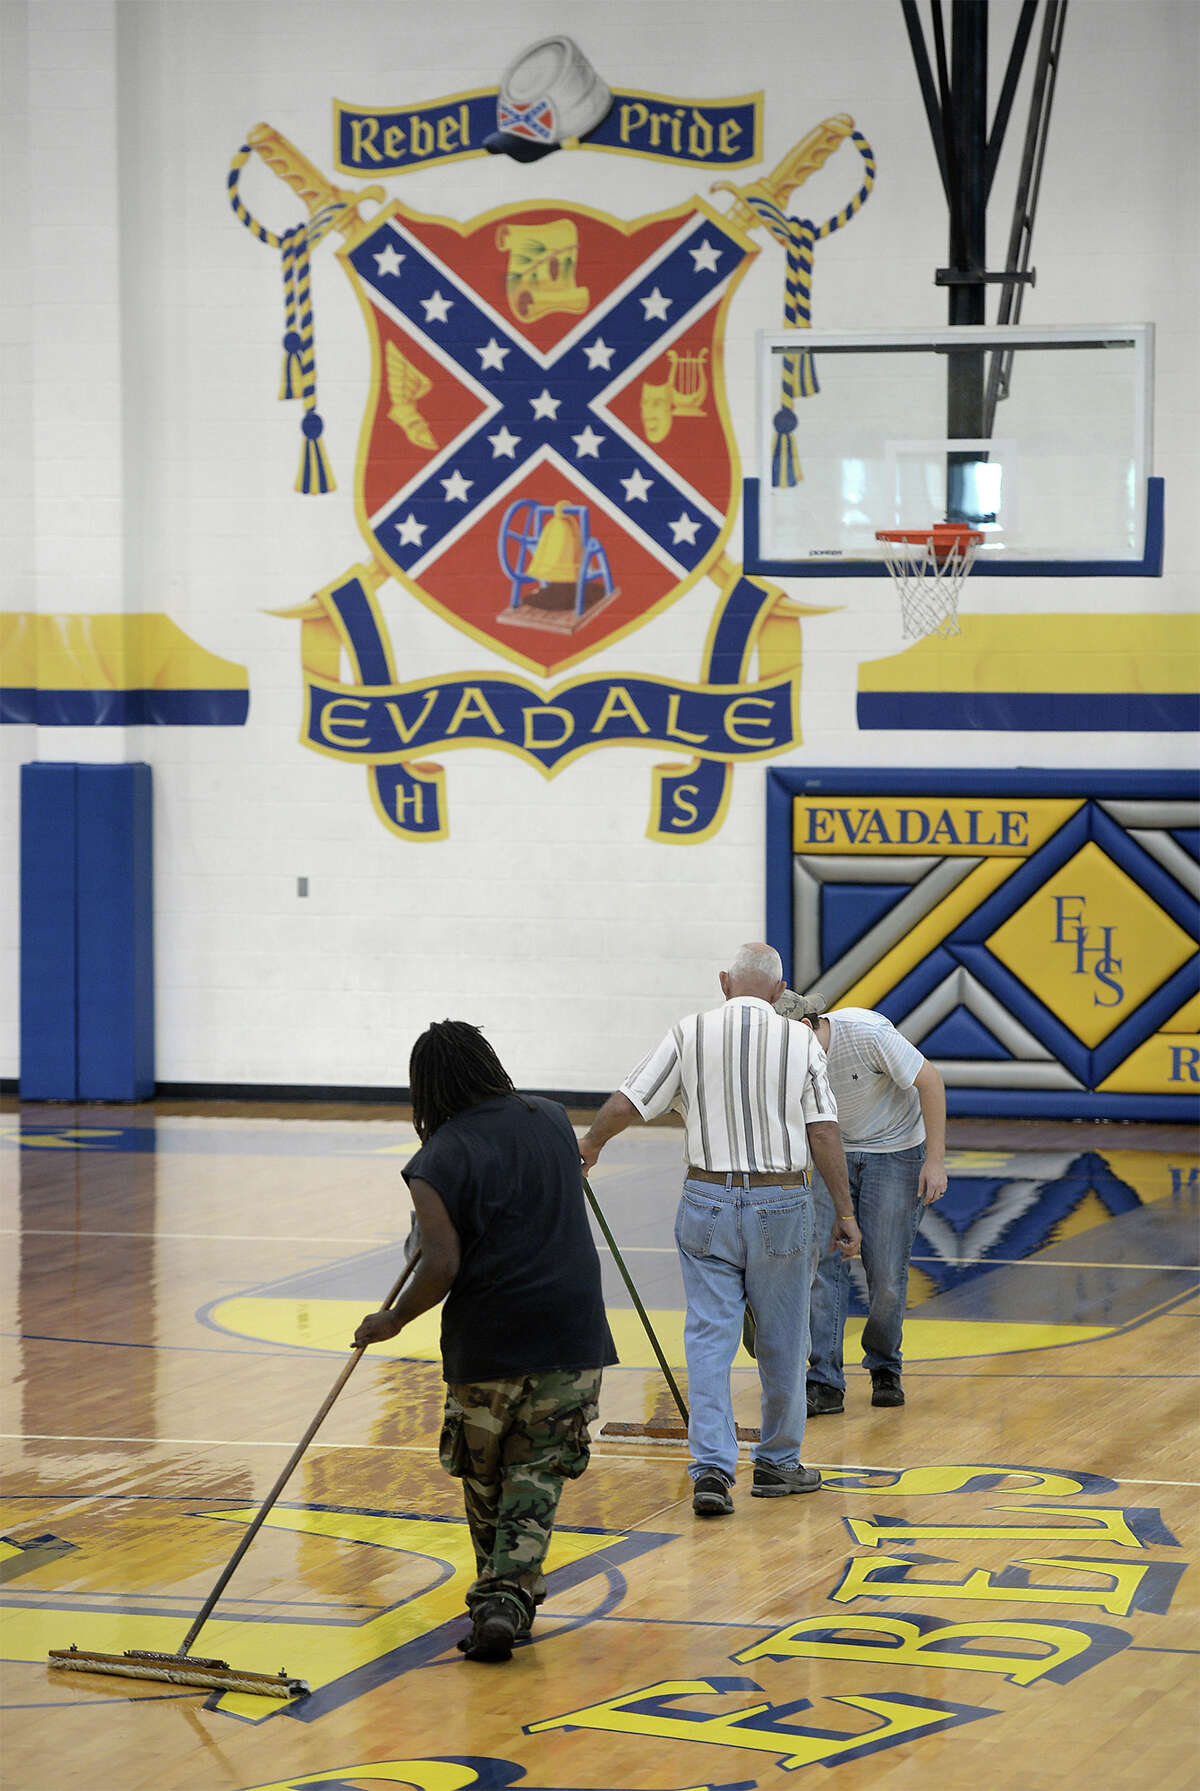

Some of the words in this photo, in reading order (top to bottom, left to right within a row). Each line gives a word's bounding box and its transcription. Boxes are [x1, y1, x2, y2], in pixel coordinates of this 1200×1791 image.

[350, 104, 470, 163] Rebel
[619, 103, 742, 157] Pride
[319, 686, 776, 749] EVADALE
[394, 783, 425, 824] H
[670, 784, 700, 828] S
[804, 807, 1030, 847] EVADALE
